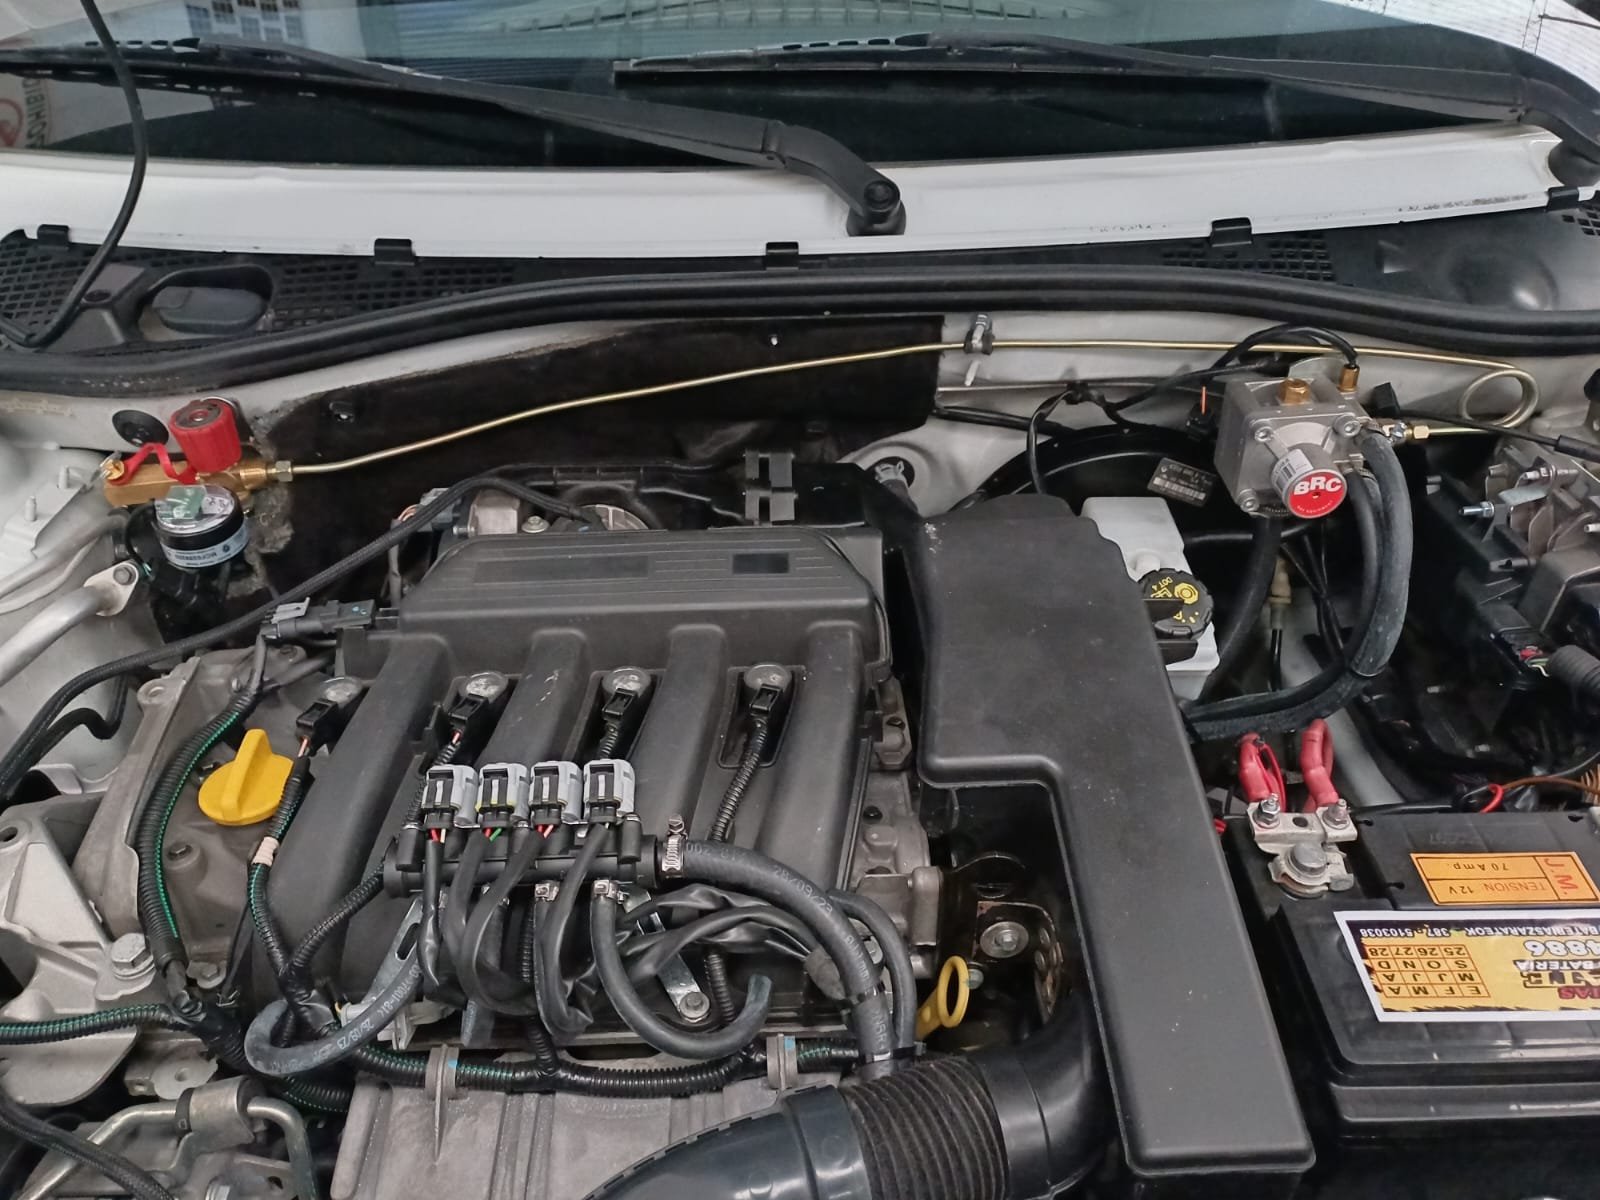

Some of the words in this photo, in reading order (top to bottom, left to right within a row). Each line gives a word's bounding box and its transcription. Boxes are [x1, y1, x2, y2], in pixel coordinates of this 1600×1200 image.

[1293, 476, 1342, 495] BRC
[1159, 576, 1173, 589] DOT
[1491, 863, 1509, 871] 70
[1484, 881, 1547, 892] TENSION
[1427, 927, 1450, 937] 387
[1369, 947, 1389, 956] 28
[1394, 947, 1414, 956] 27
[1417, 947, 1438, 956] 26
[1443, 947, 1466, 956] 25
[1377, 960, 1392, 970] D
[1402, 960, 1417, 969] N
[1427, 960, 1442, 969] O
[1455, 960, 1468, 969] S
[1382, 973, 1396, 982] A
[1412, 973, 1422, 982] J
[1438, 973, 1447, 982] J
[1459, 973, 1475, 982] M
[1388, 986, 1401, 996] A
[1412, 986, 1430, 996] M
[1445, 986, 1456, 995] F
[1470, 986, 1482, 996] E
